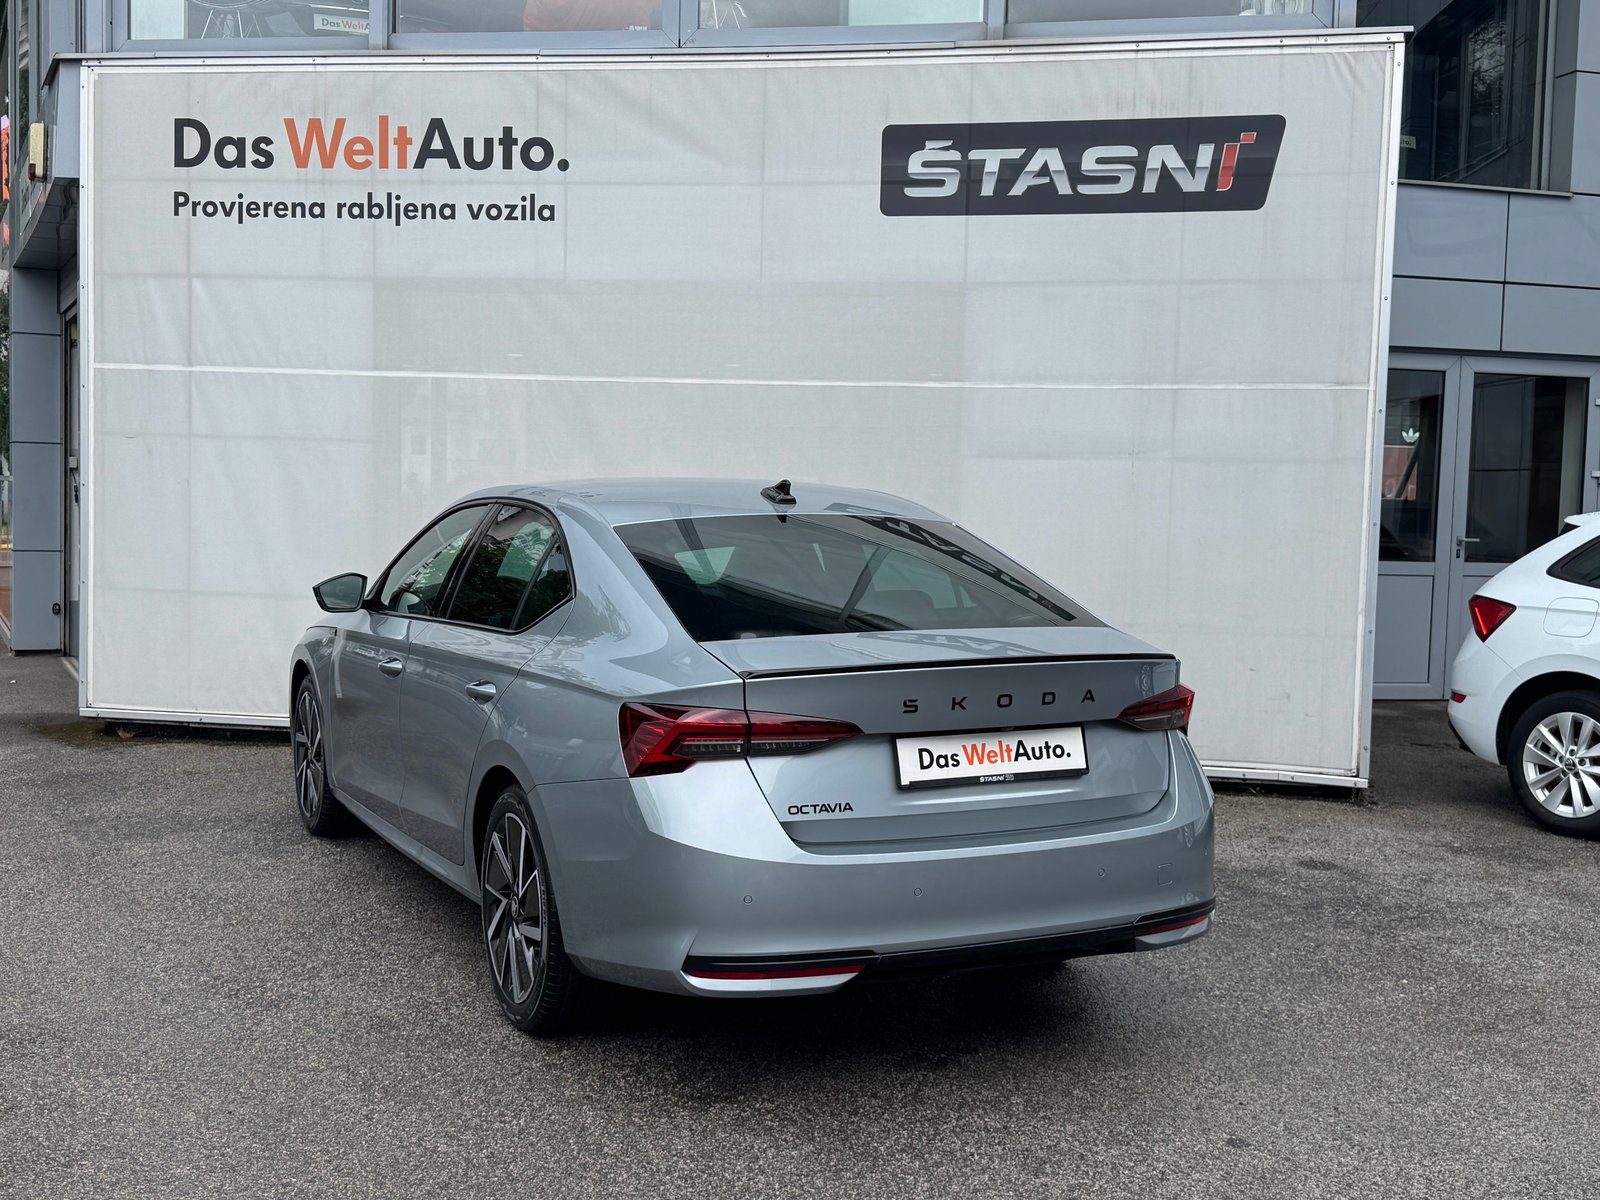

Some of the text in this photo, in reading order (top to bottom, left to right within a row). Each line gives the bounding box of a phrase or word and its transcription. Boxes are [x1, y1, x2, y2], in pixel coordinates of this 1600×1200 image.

[321, 17, 341, 28] Das
[173, 114, 570, 172] Das WeltAuto.
[173, 191, 556, 227] Provjerena rabljena vozila
[918, 739, 1072, 771] Das WeltAuto.
[788, 802, 854, 815] OCTAVIA
